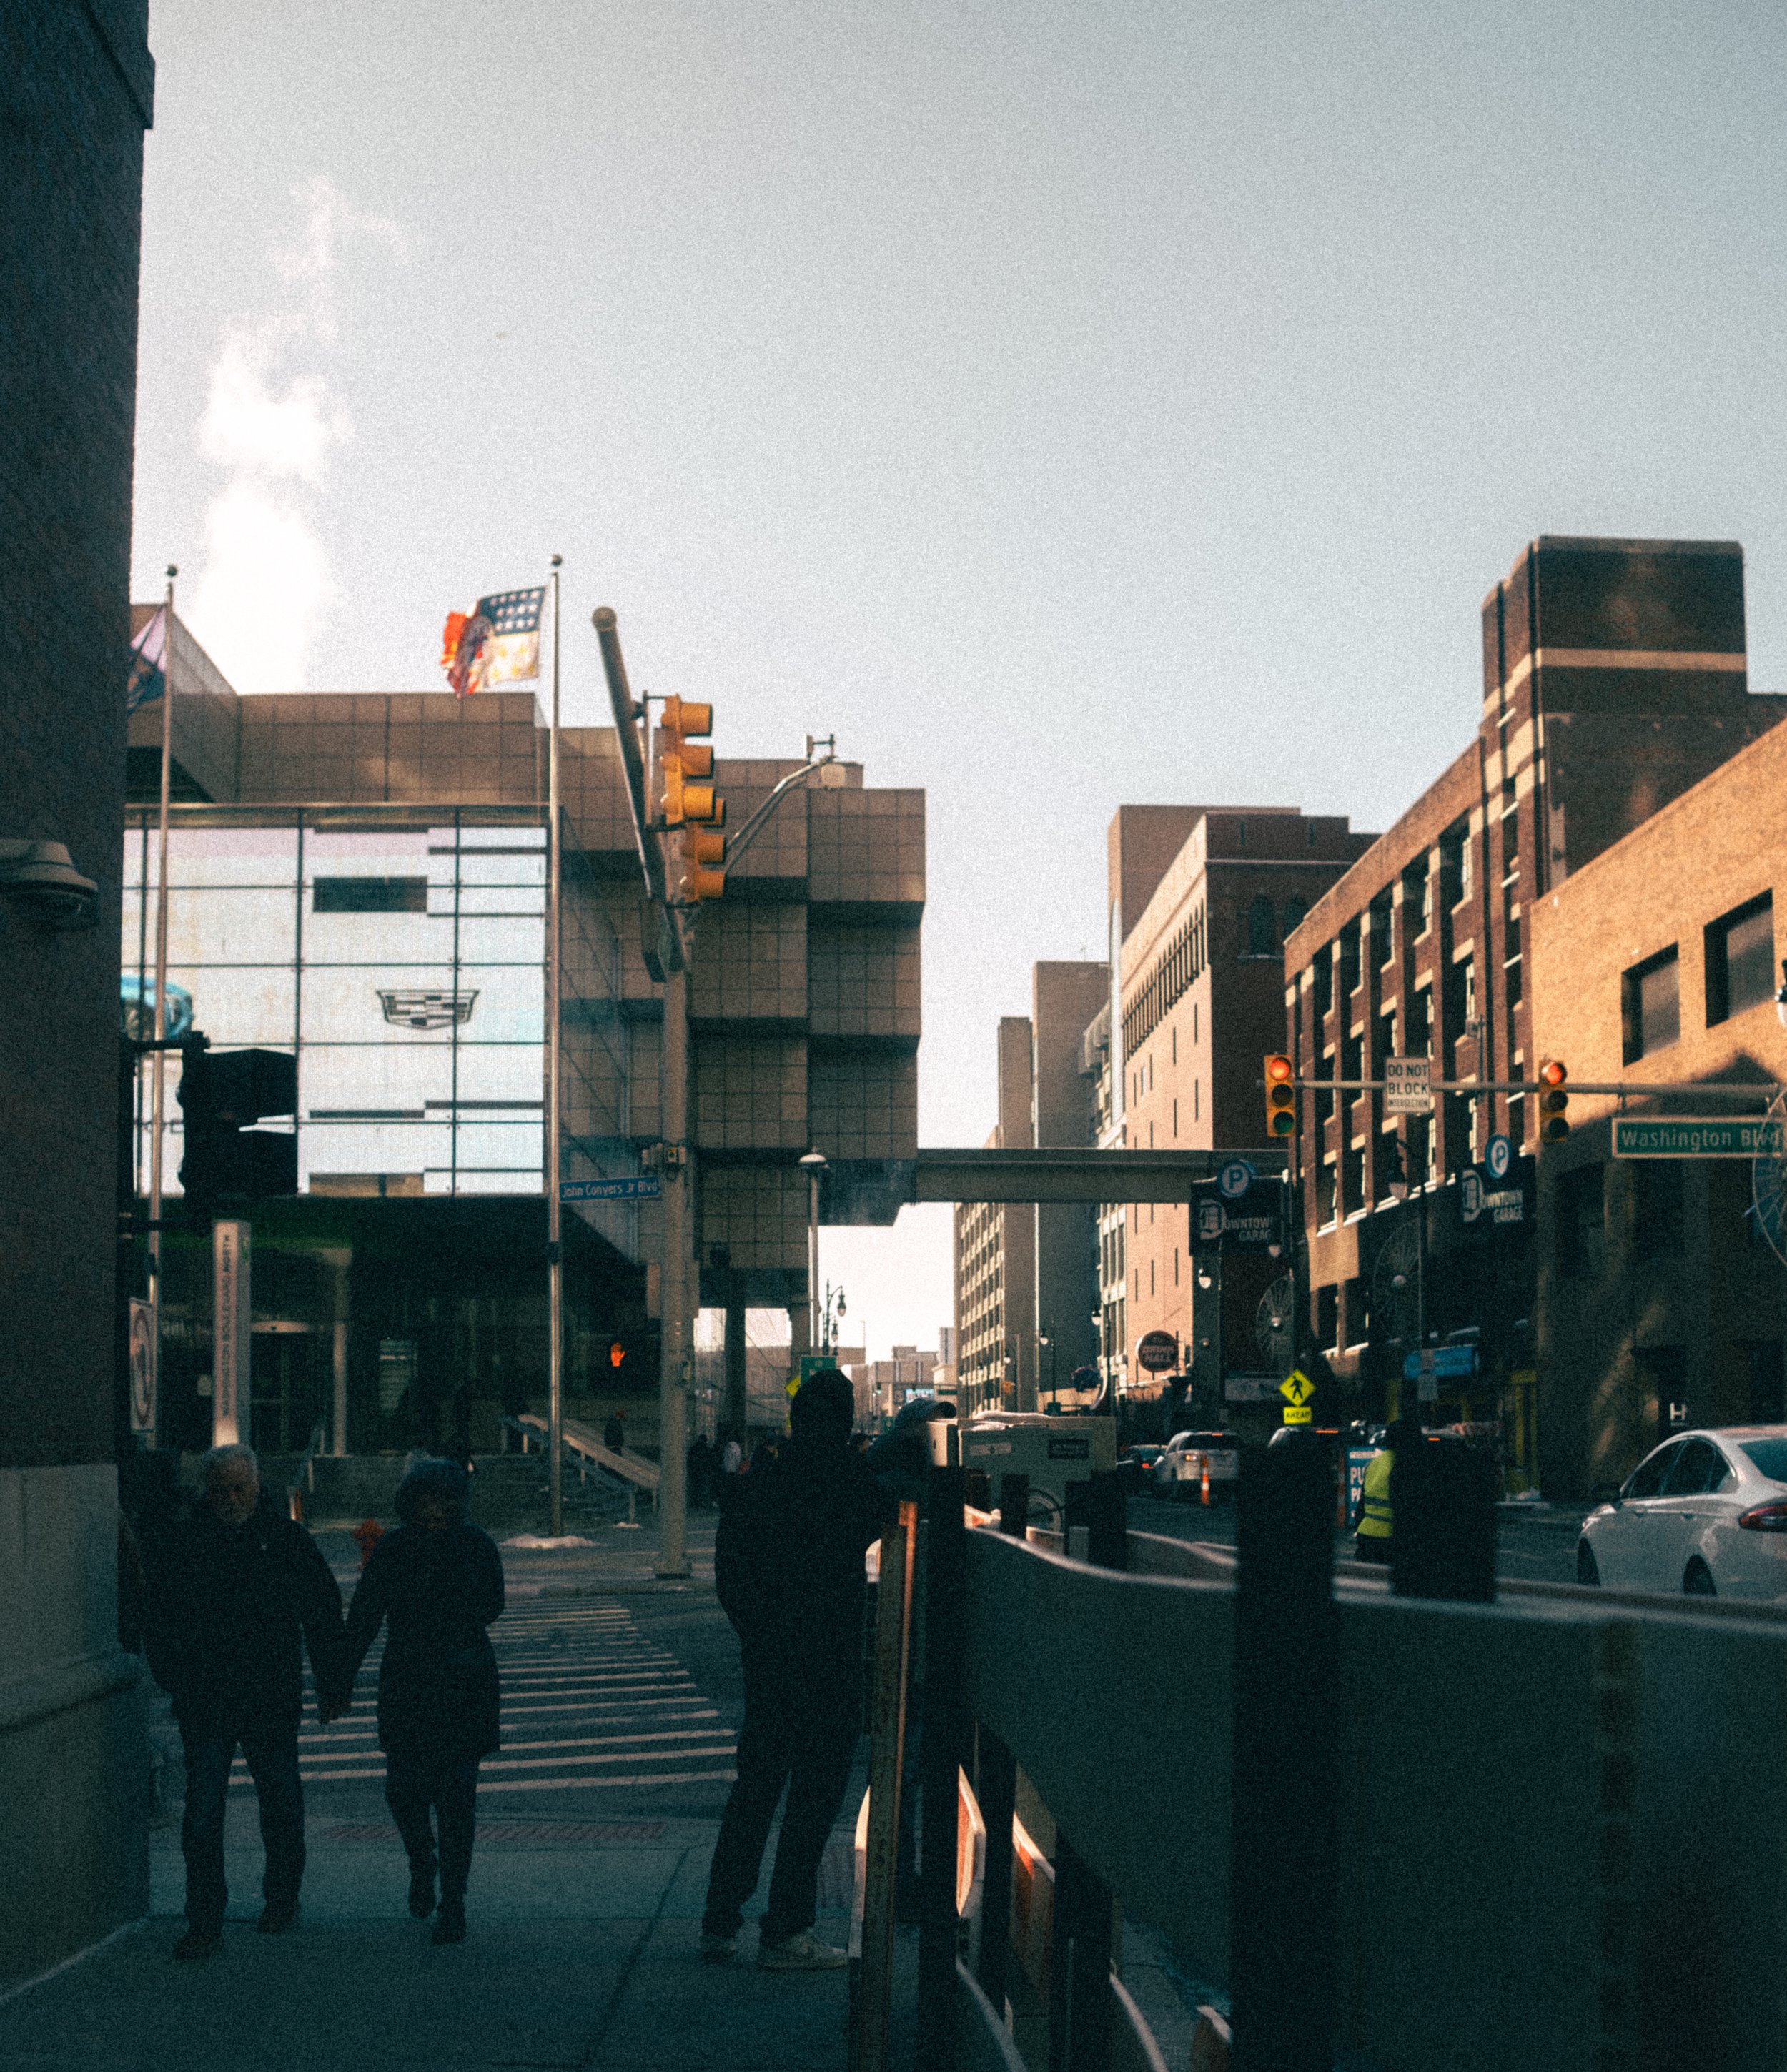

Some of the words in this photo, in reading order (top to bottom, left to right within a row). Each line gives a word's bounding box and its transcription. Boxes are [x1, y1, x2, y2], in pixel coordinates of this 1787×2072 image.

[1388, 1064, 1403, 1076] DO
[1406, 1064, 1427, 1076] NOT
[1388, 1083, 1427, 1095] BLOCK
[1622, 1129, 1731, 1151] Washington
[1740, 1129, 1779, 1146] Blvd
[1495, 1146, 1506, 1168] P
[1229, 1169, 1244, 1189] P
[563, 1186, 583, 1198] John
[585, 1184, 623, 1196] Conyers
[627, 1182, 635, 1193] Jr
[638, 1181, 657, 1192] Blvd
